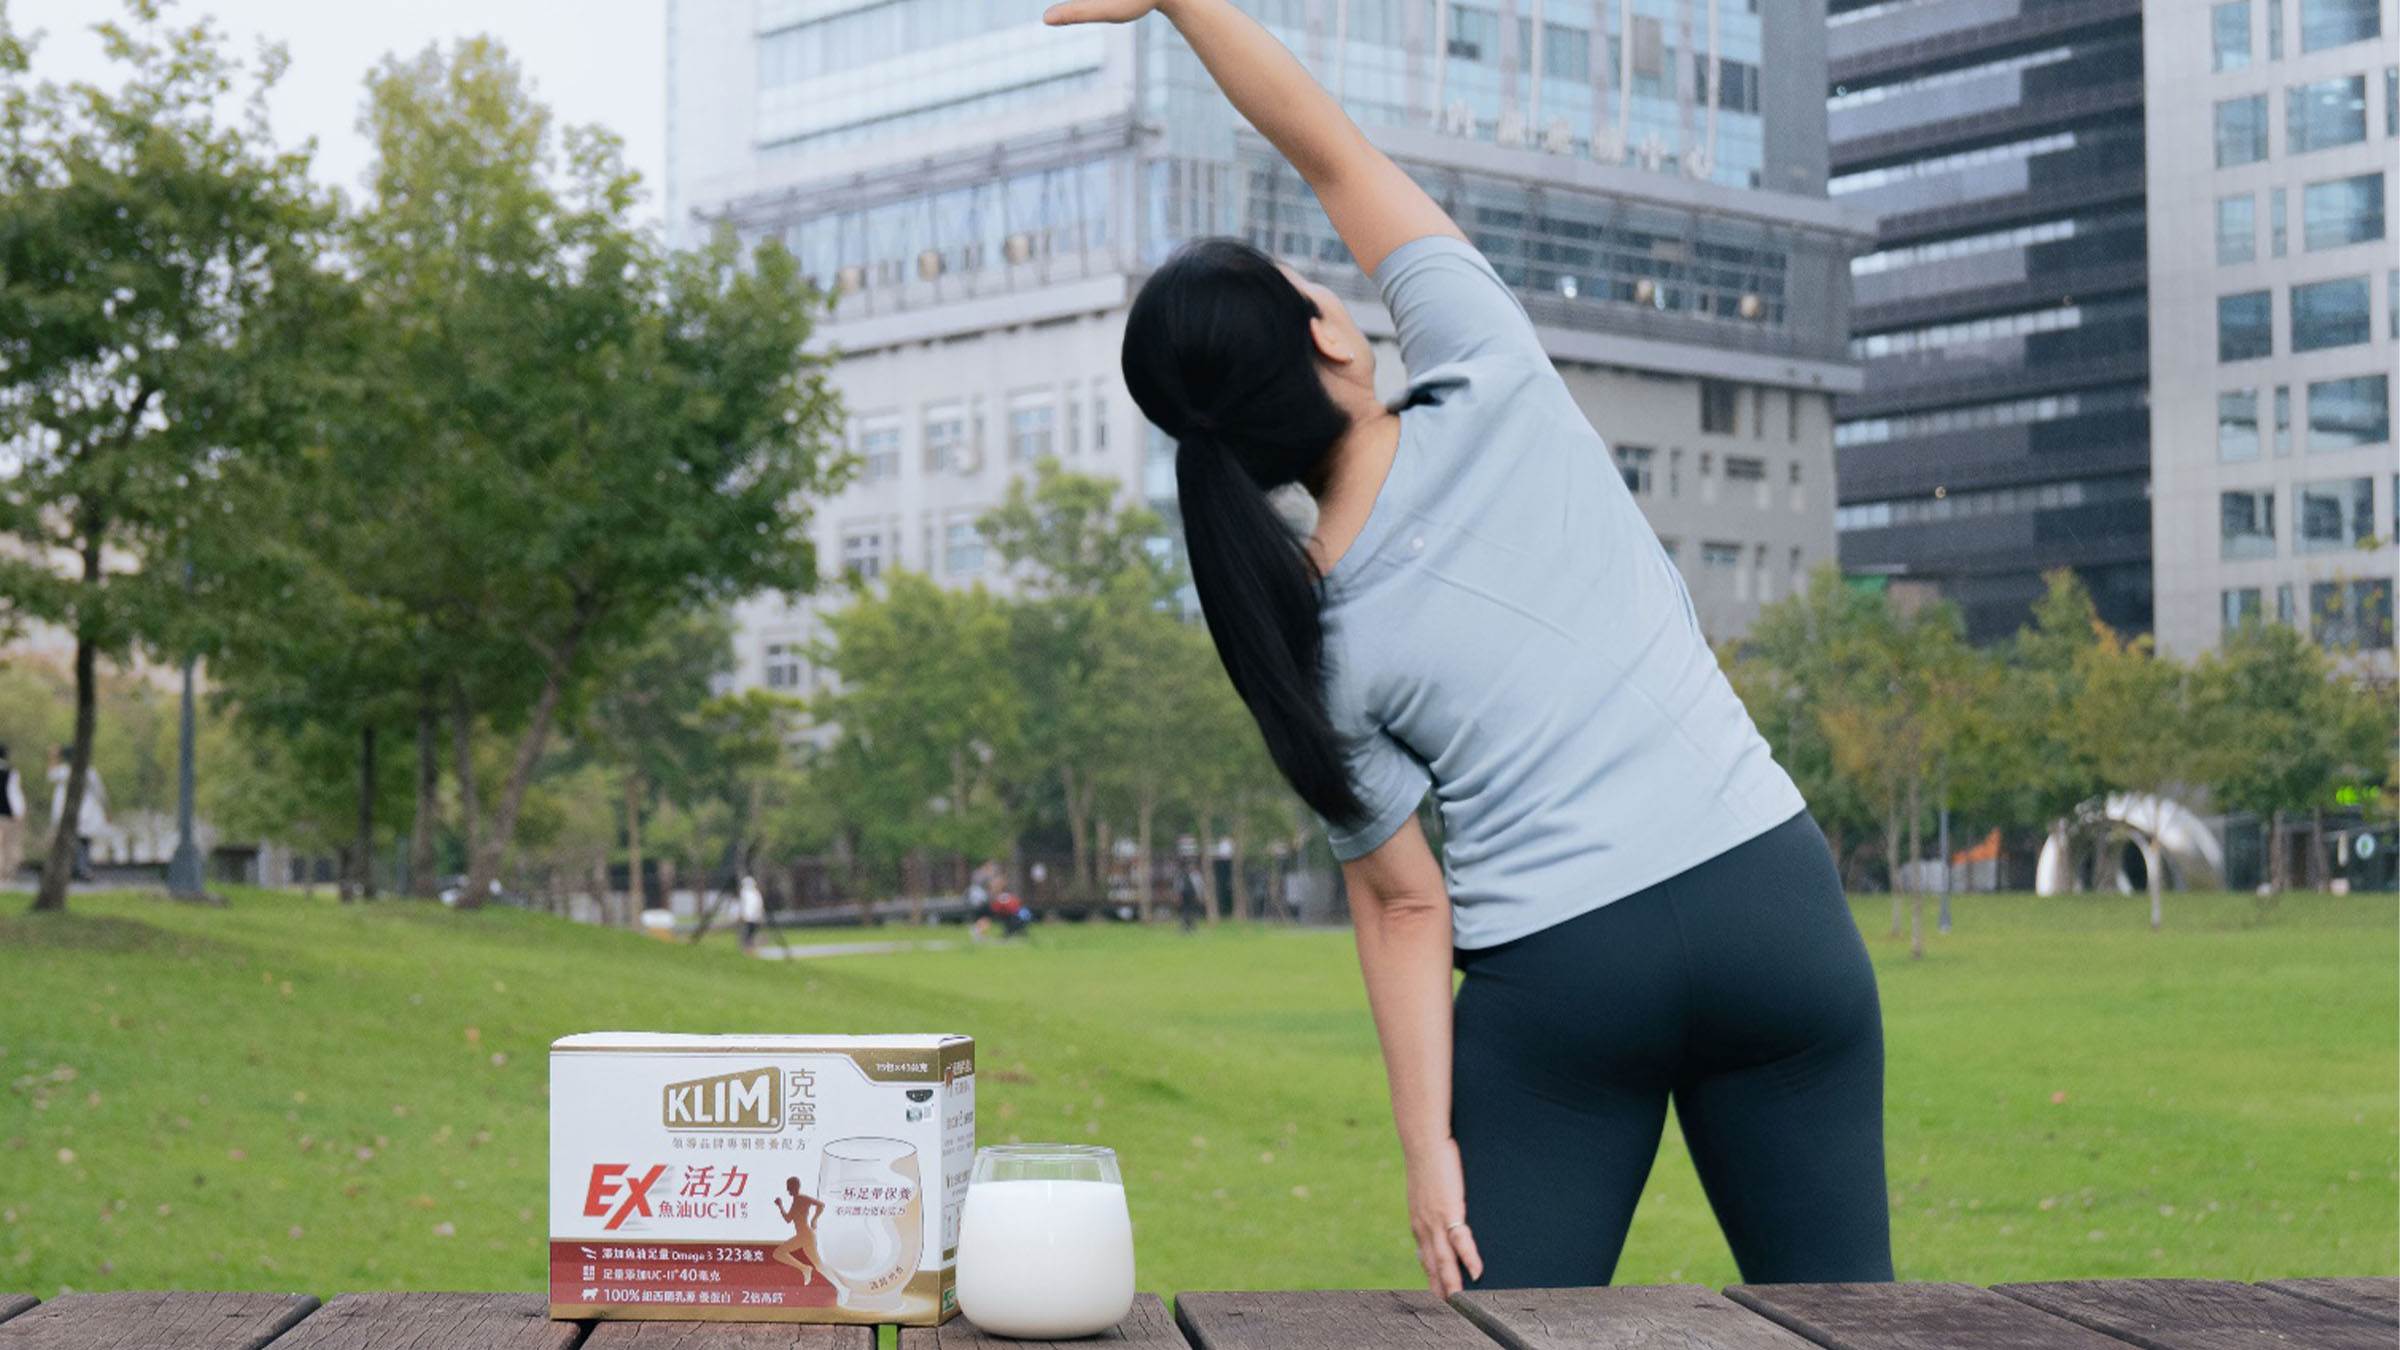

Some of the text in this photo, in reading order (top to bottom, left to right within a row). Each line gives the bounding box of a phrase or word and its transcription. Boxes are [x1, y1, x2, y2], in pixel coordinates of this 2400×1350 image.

[668, 1074, 770, 1124] KLIM
[788, 1068, 816, 1131] 克寧
[583, 1164, 668, 1230] EX
[680, 1165, 749, 1198] 活力
[603, 1289, 639, 1302] 100%
